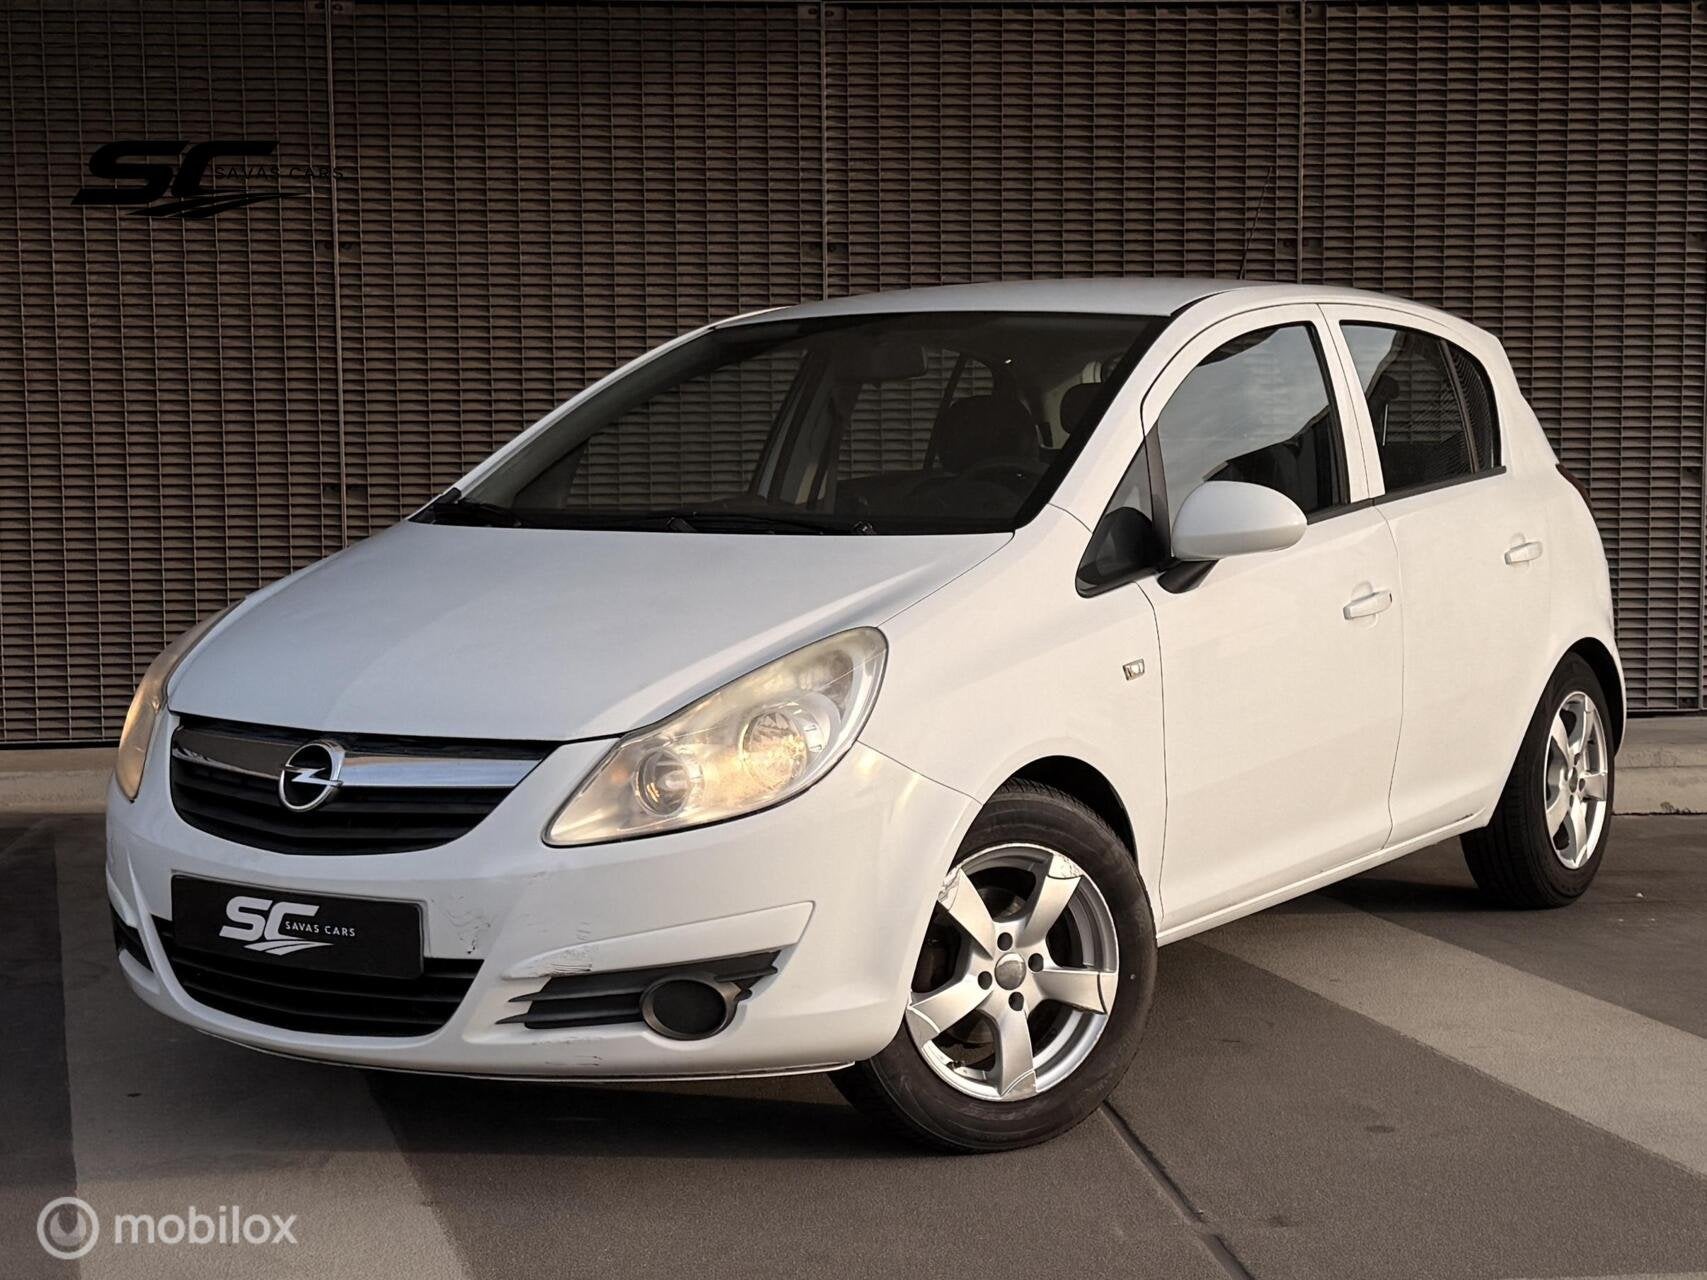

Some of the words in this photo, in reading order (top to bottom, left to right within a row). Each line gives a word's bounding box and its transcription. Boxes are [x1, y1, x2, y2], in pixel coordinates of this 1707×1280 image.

[71, 140, 280, 205] SC
[214, 167, 281, 180] SAVAS
[288, 167, 344, 180] CARS
[219, 896, 320, 942] SC
[284, 921, 320, 934] SAVAS
[324, 925, 356, 937] CARS
